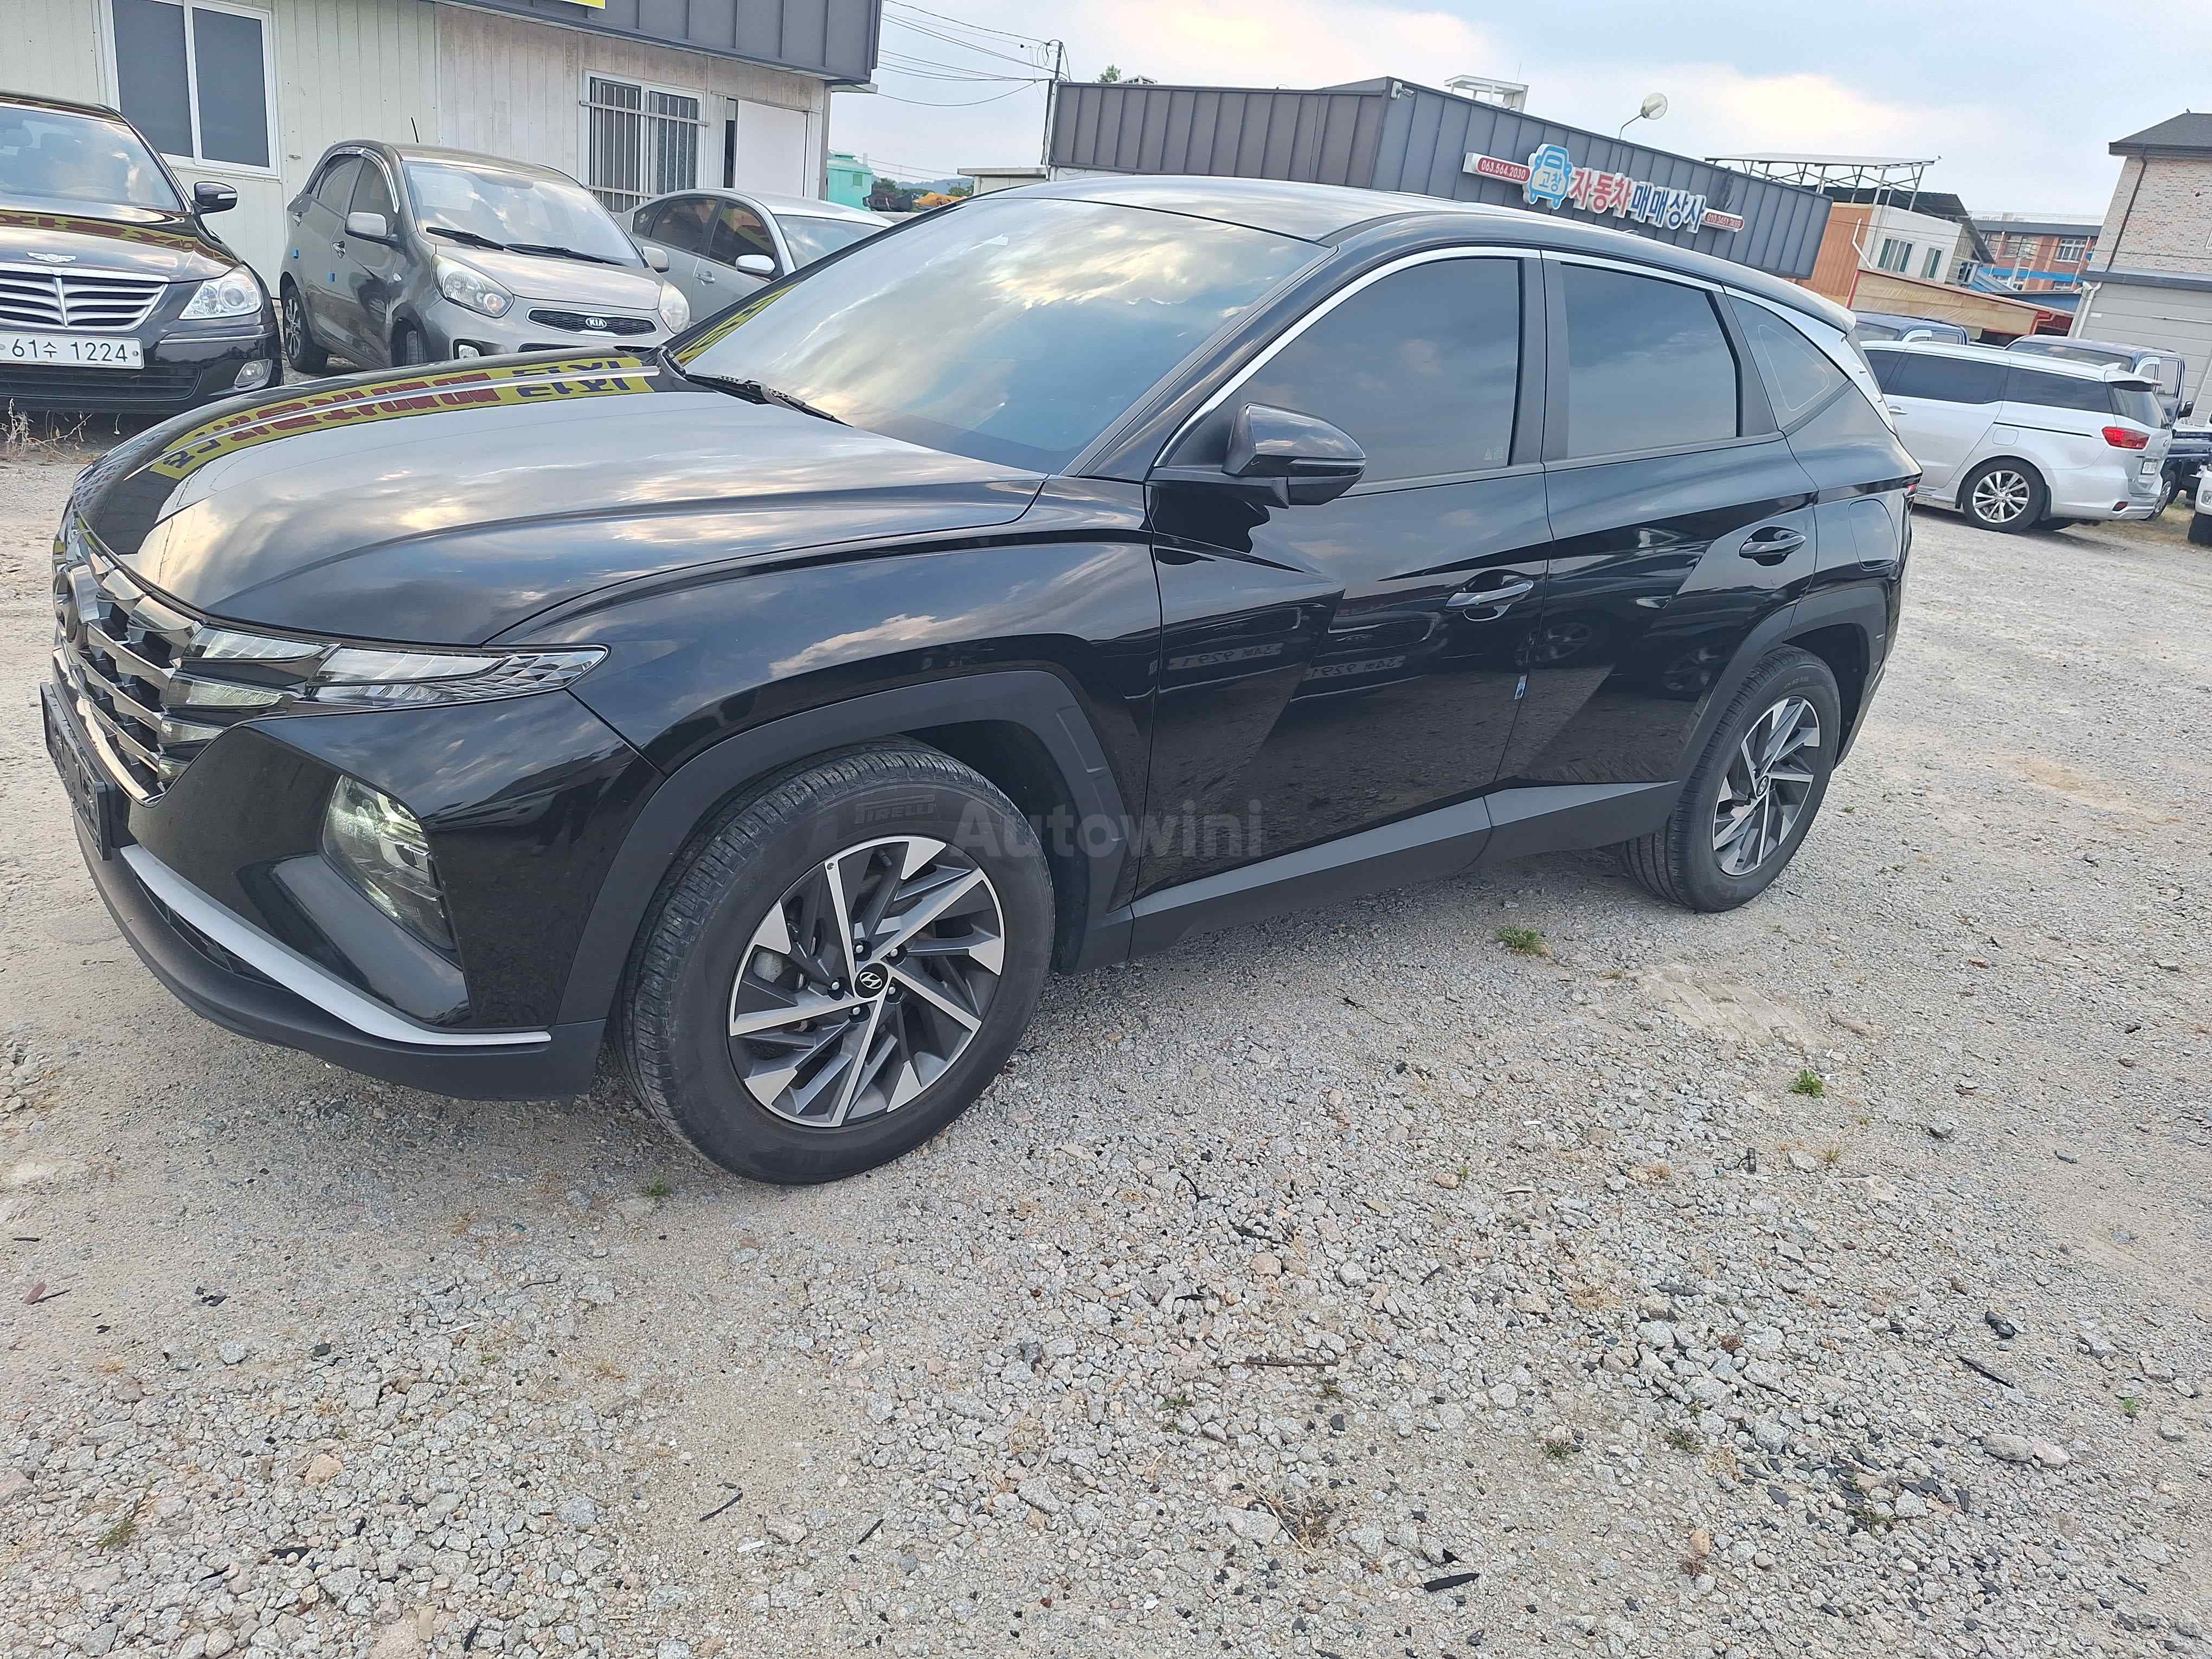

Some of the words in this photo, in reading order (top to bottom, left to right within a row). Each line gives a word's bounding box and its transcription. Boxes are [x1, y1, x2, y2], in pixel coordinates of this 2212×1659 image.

[1481, 159, 1526, 180] 063.564.2030
[1538, 170, 1562, 192] 고창
[589, 318, 604, 327] KIA
[11, 338, 58, 358] 61수
[70, 341, 128, 363] 1224
